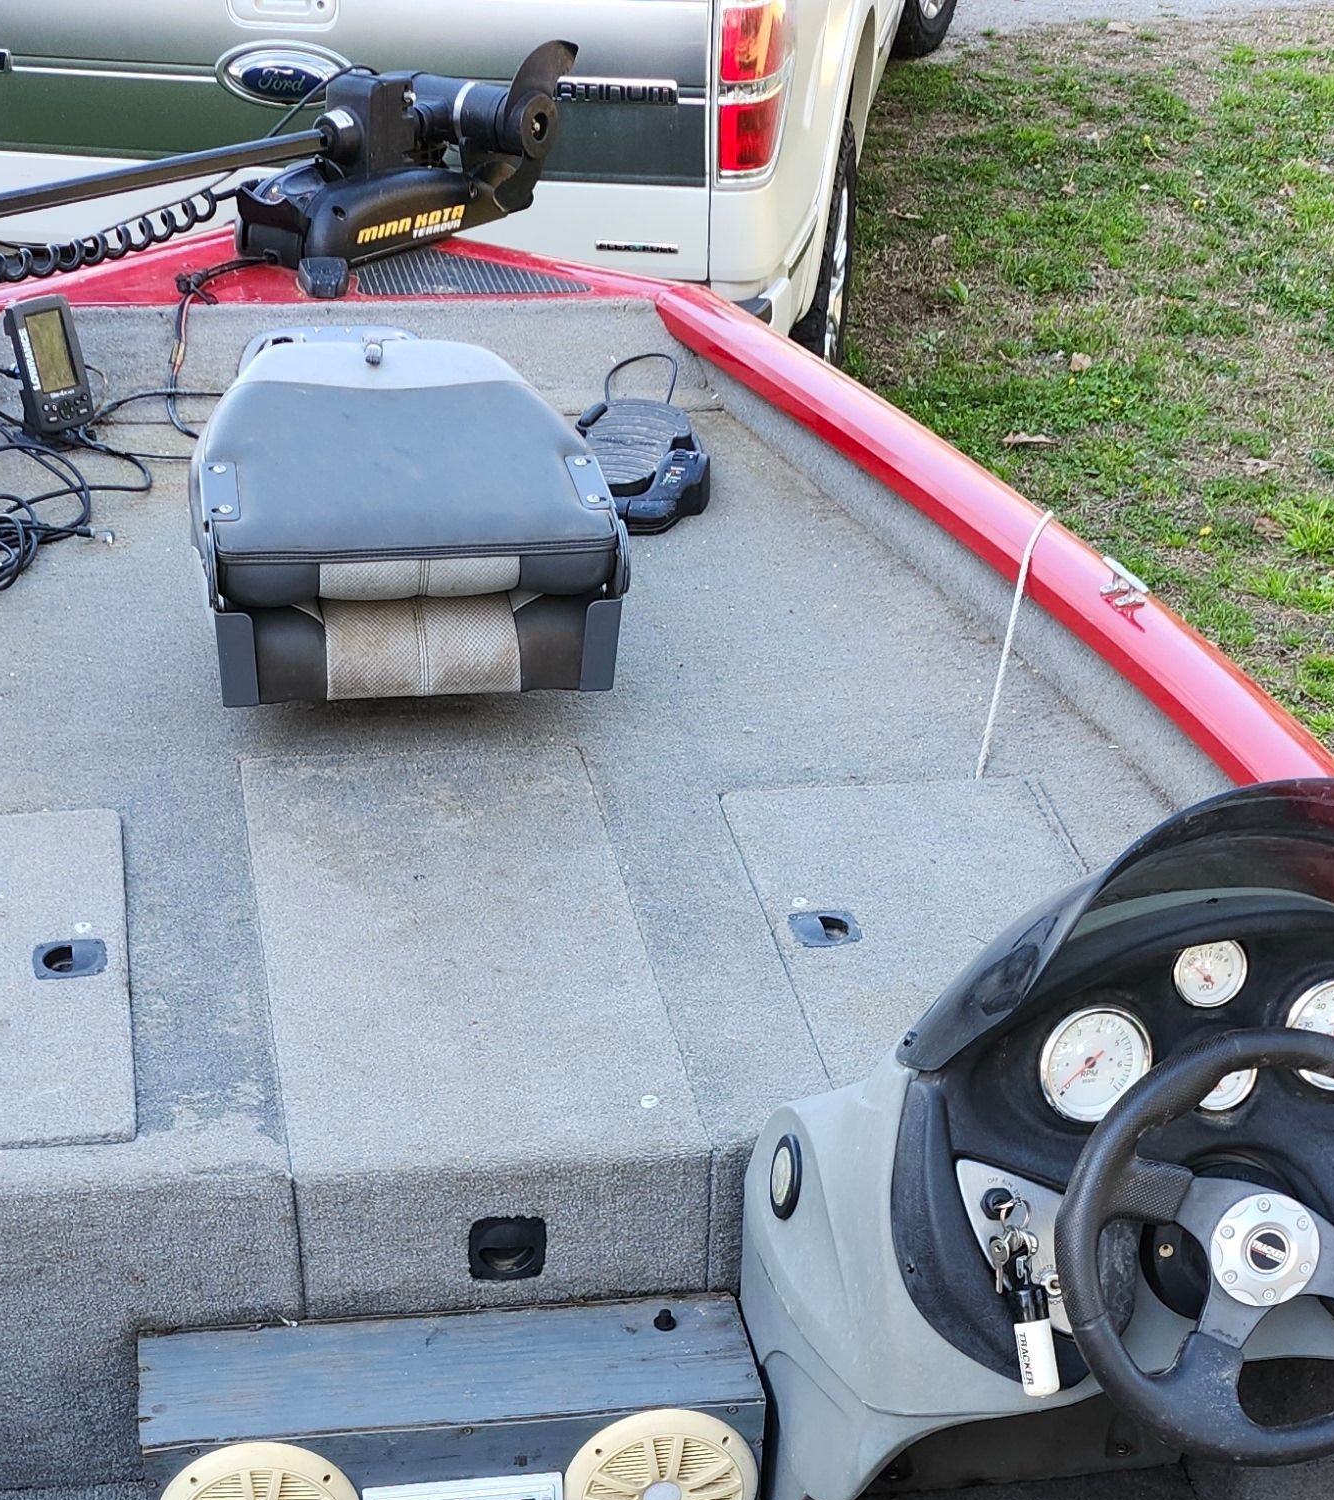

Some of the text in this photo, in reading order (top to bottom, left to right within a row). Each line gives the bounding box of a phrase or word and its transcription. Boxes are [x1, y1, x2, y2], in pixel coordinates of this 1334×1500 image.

[258, 67, 306, 92] Ford
[554, 77, 678, 106] ATINUM
[357, 204, 465, 245] MINN KOTA
[19, 327, 41, 391] LOWRANCE
[1080, 1068, 1099, 1079] RPM
[1250, 1240, 1286, 1261] TRACKER
[1018, 1332, 1035, 1385] TRACKER
